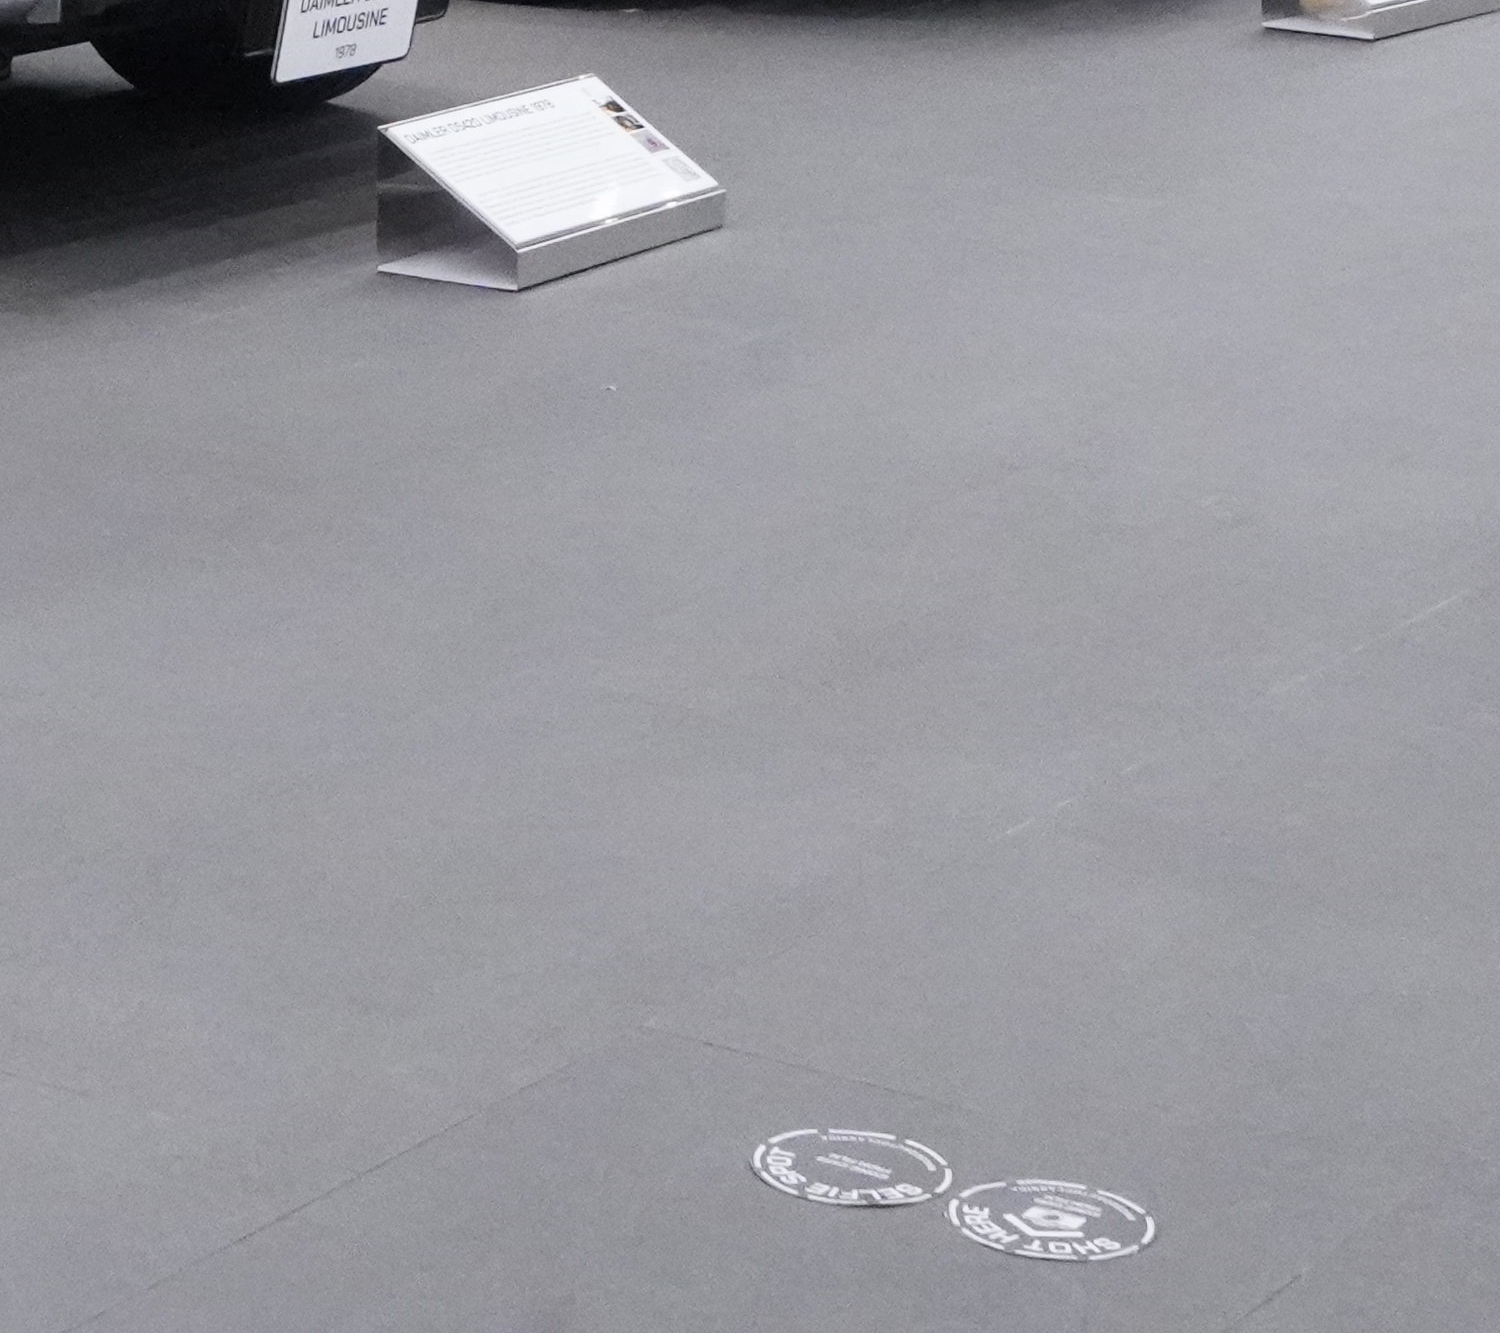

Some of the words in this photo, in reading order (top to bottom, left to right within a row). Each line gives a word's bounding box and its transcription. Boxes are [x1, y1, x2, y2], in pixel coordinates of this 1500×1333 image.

[312, 7, 389, 39] LIMOUSINE
[961, 1204, 1020, 1244] HERE
[1022, 1237, 1122, 1256] SHOT
